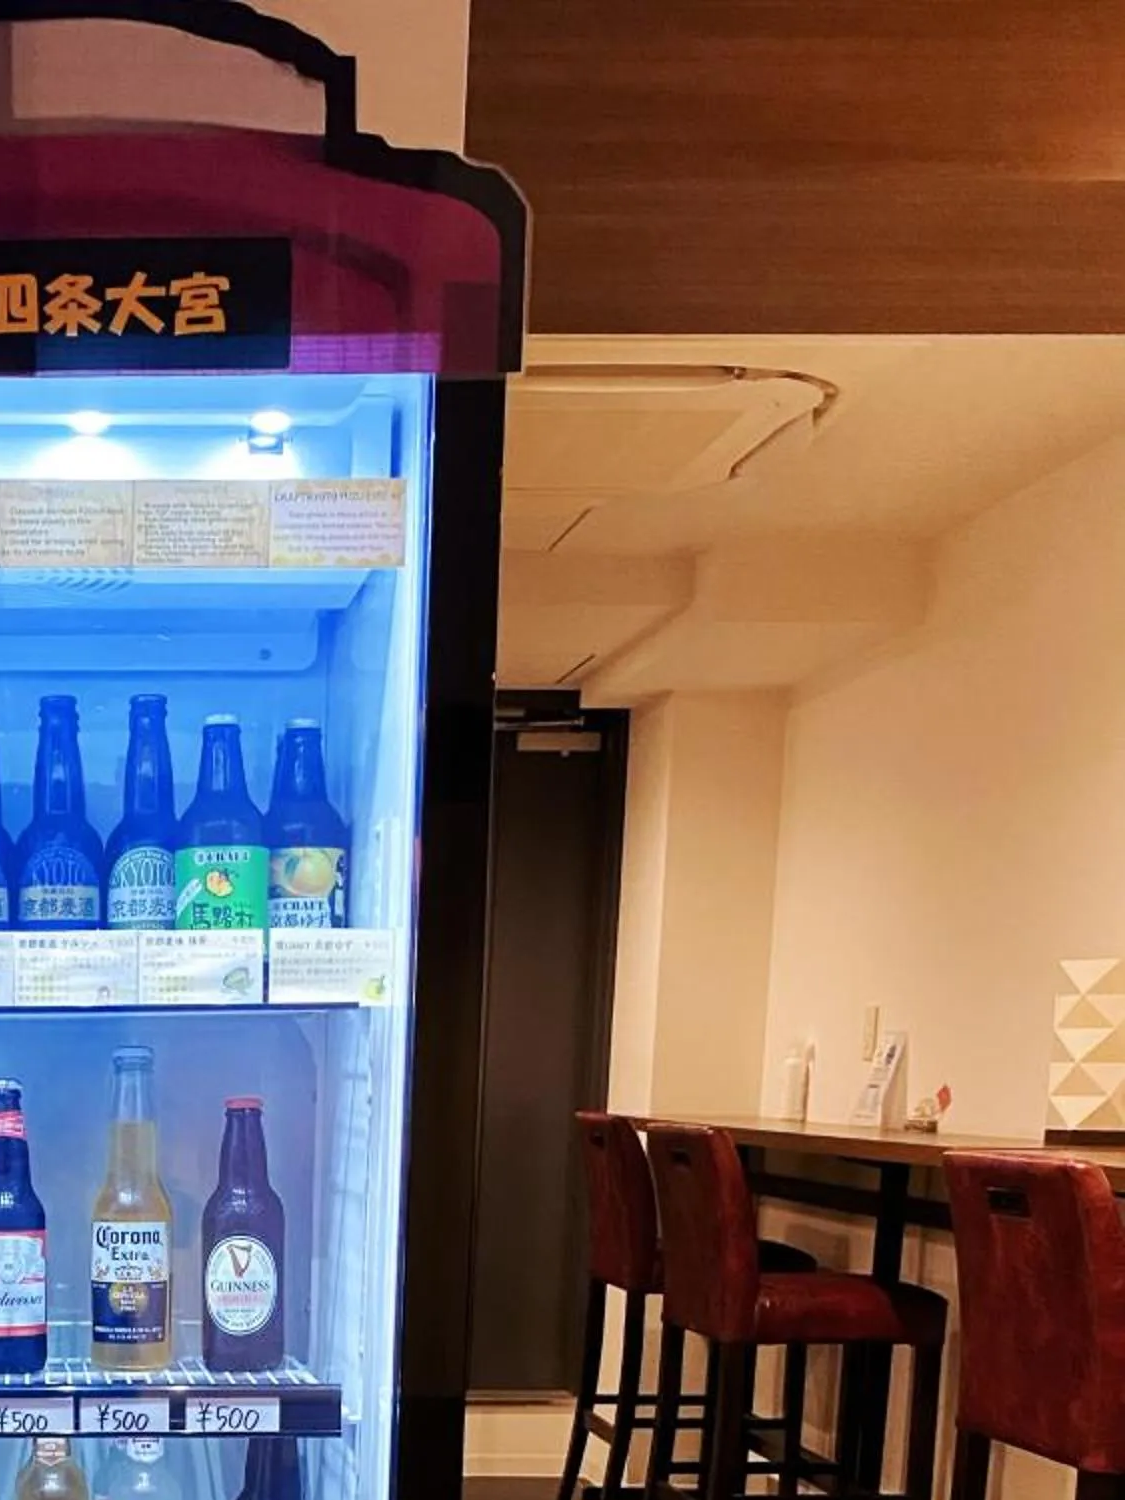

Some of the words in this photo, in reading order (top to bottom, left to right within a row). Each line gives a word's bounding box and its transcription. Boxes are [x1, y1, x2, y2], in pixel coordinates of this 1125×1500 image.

[111, 899, 174, 919] 京都麦
[96, 1225, 163, 1250] Corona
[111, 1247, 151, 1261] Extra
[211, 1280, 271, 1294] GUINNESS
[97, 1404, 150, 1431] ¥500
[196, 1402, 260, 1431] ¥500
